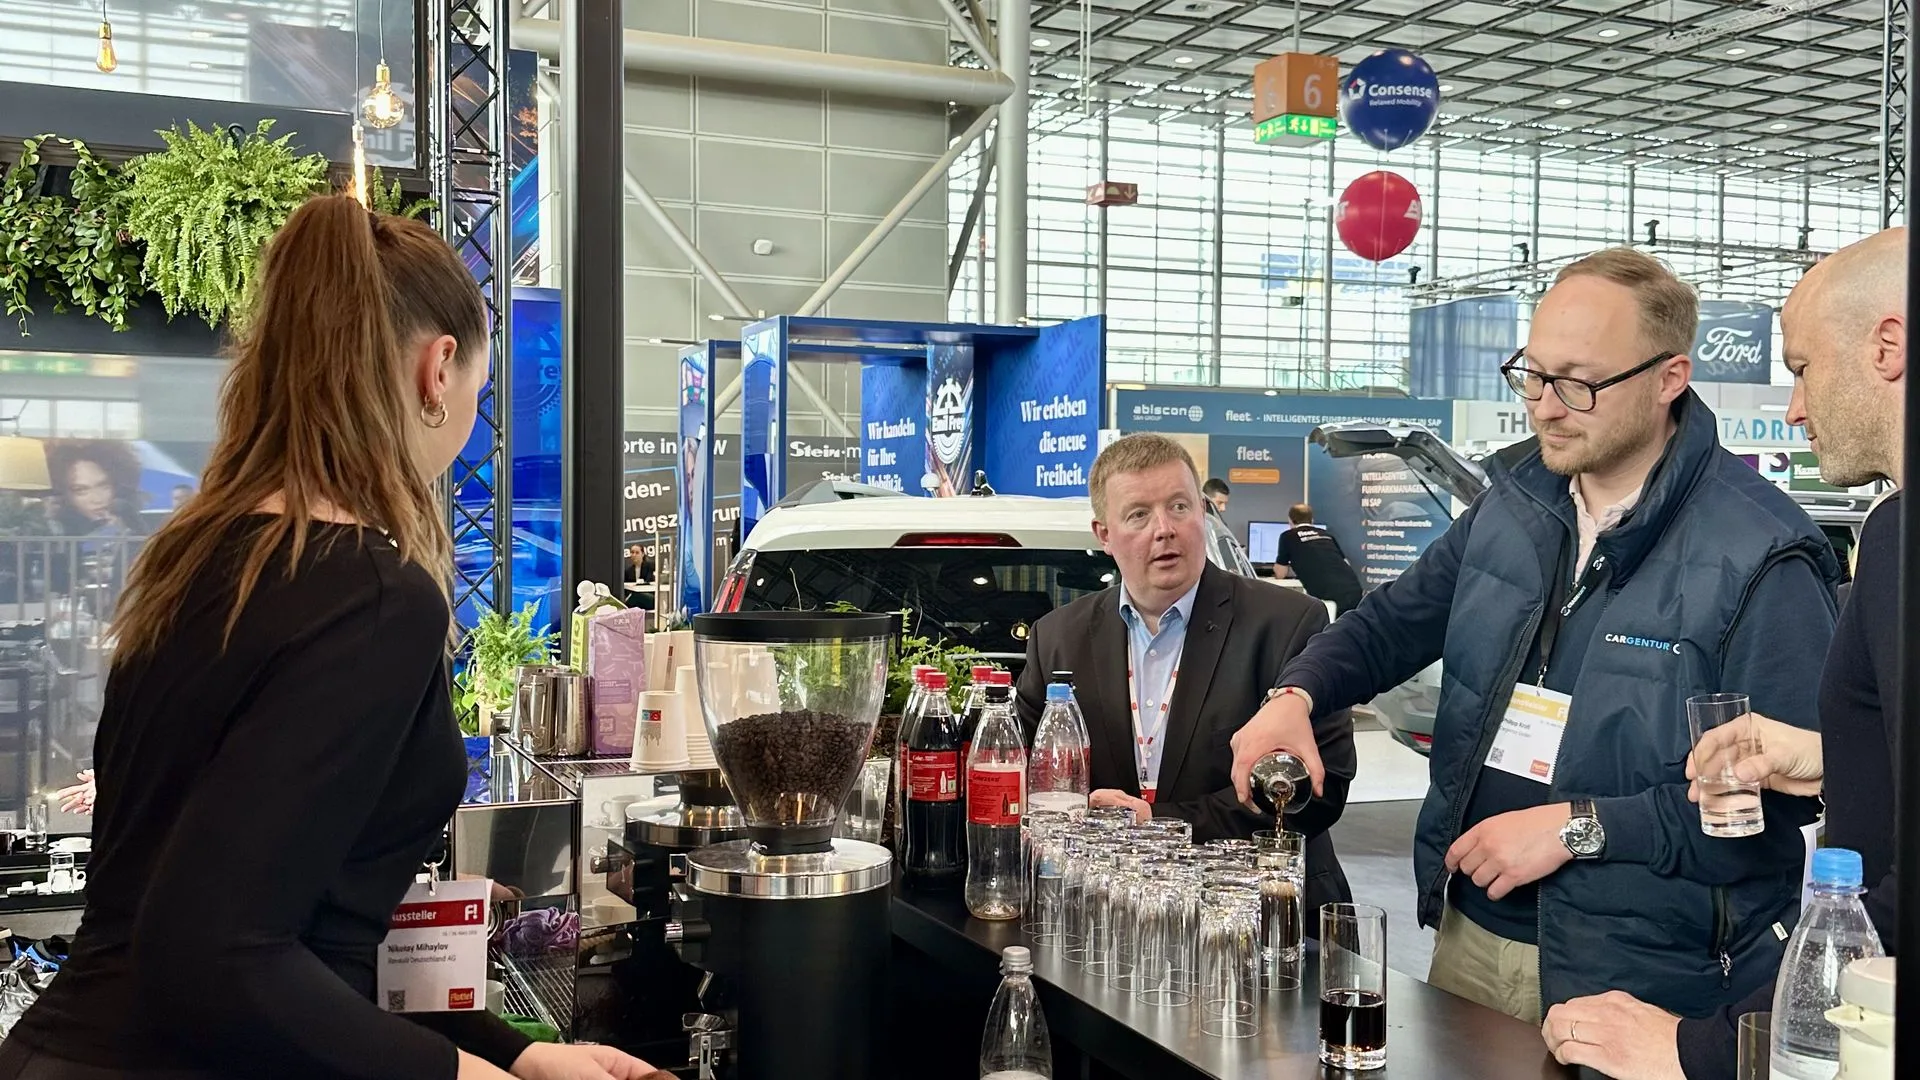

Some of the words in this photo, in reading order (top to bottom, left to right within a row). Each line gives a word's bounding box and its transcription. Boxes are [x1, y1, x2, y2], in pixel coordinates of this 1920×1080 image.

[1303, 73, 1322, 110] 6
[1368, 83, 1432, 99] Consense
[1369, 99, 1396, 107] Relaxed
[1397, 98, 1423, 108] Mobility
[1697, 326, 1763, 364] Ford
[1020, 399, 1042, 423] Wir
[1042, 394, 1087, 420] erleben
[1133, 404, 1187, 416] abiscon
[932, 416, 948, 432] Emil
[949, 417, 966, 434] Frey
[1225, 409, 1253, 422] fleet.
[1263, 414, 1320, 425] INTELLIGENTES
[1427, 418, 1442, 427] SAP
[867, 422, 883, 441] Wir
[882, 417, 916, 438] handeln
[660, 437, 677, 454] in
[1039, 430, 1058, 454] die
[1057, 433, 1087, 452] neue
[867, 448, 880, 467] für
[880, 448, 897, 466] Ihre
[1236, 445, 1273, 462] fleet.
[1036, 462, 1087, 488] Freiheit.
[1605, 633, 1671, 651] CARGENTUR
[415, 942, 449, 953] Mihaylov
[410, 954, 446, 964] Deutschland
[447, 954, 456, 962] AG
